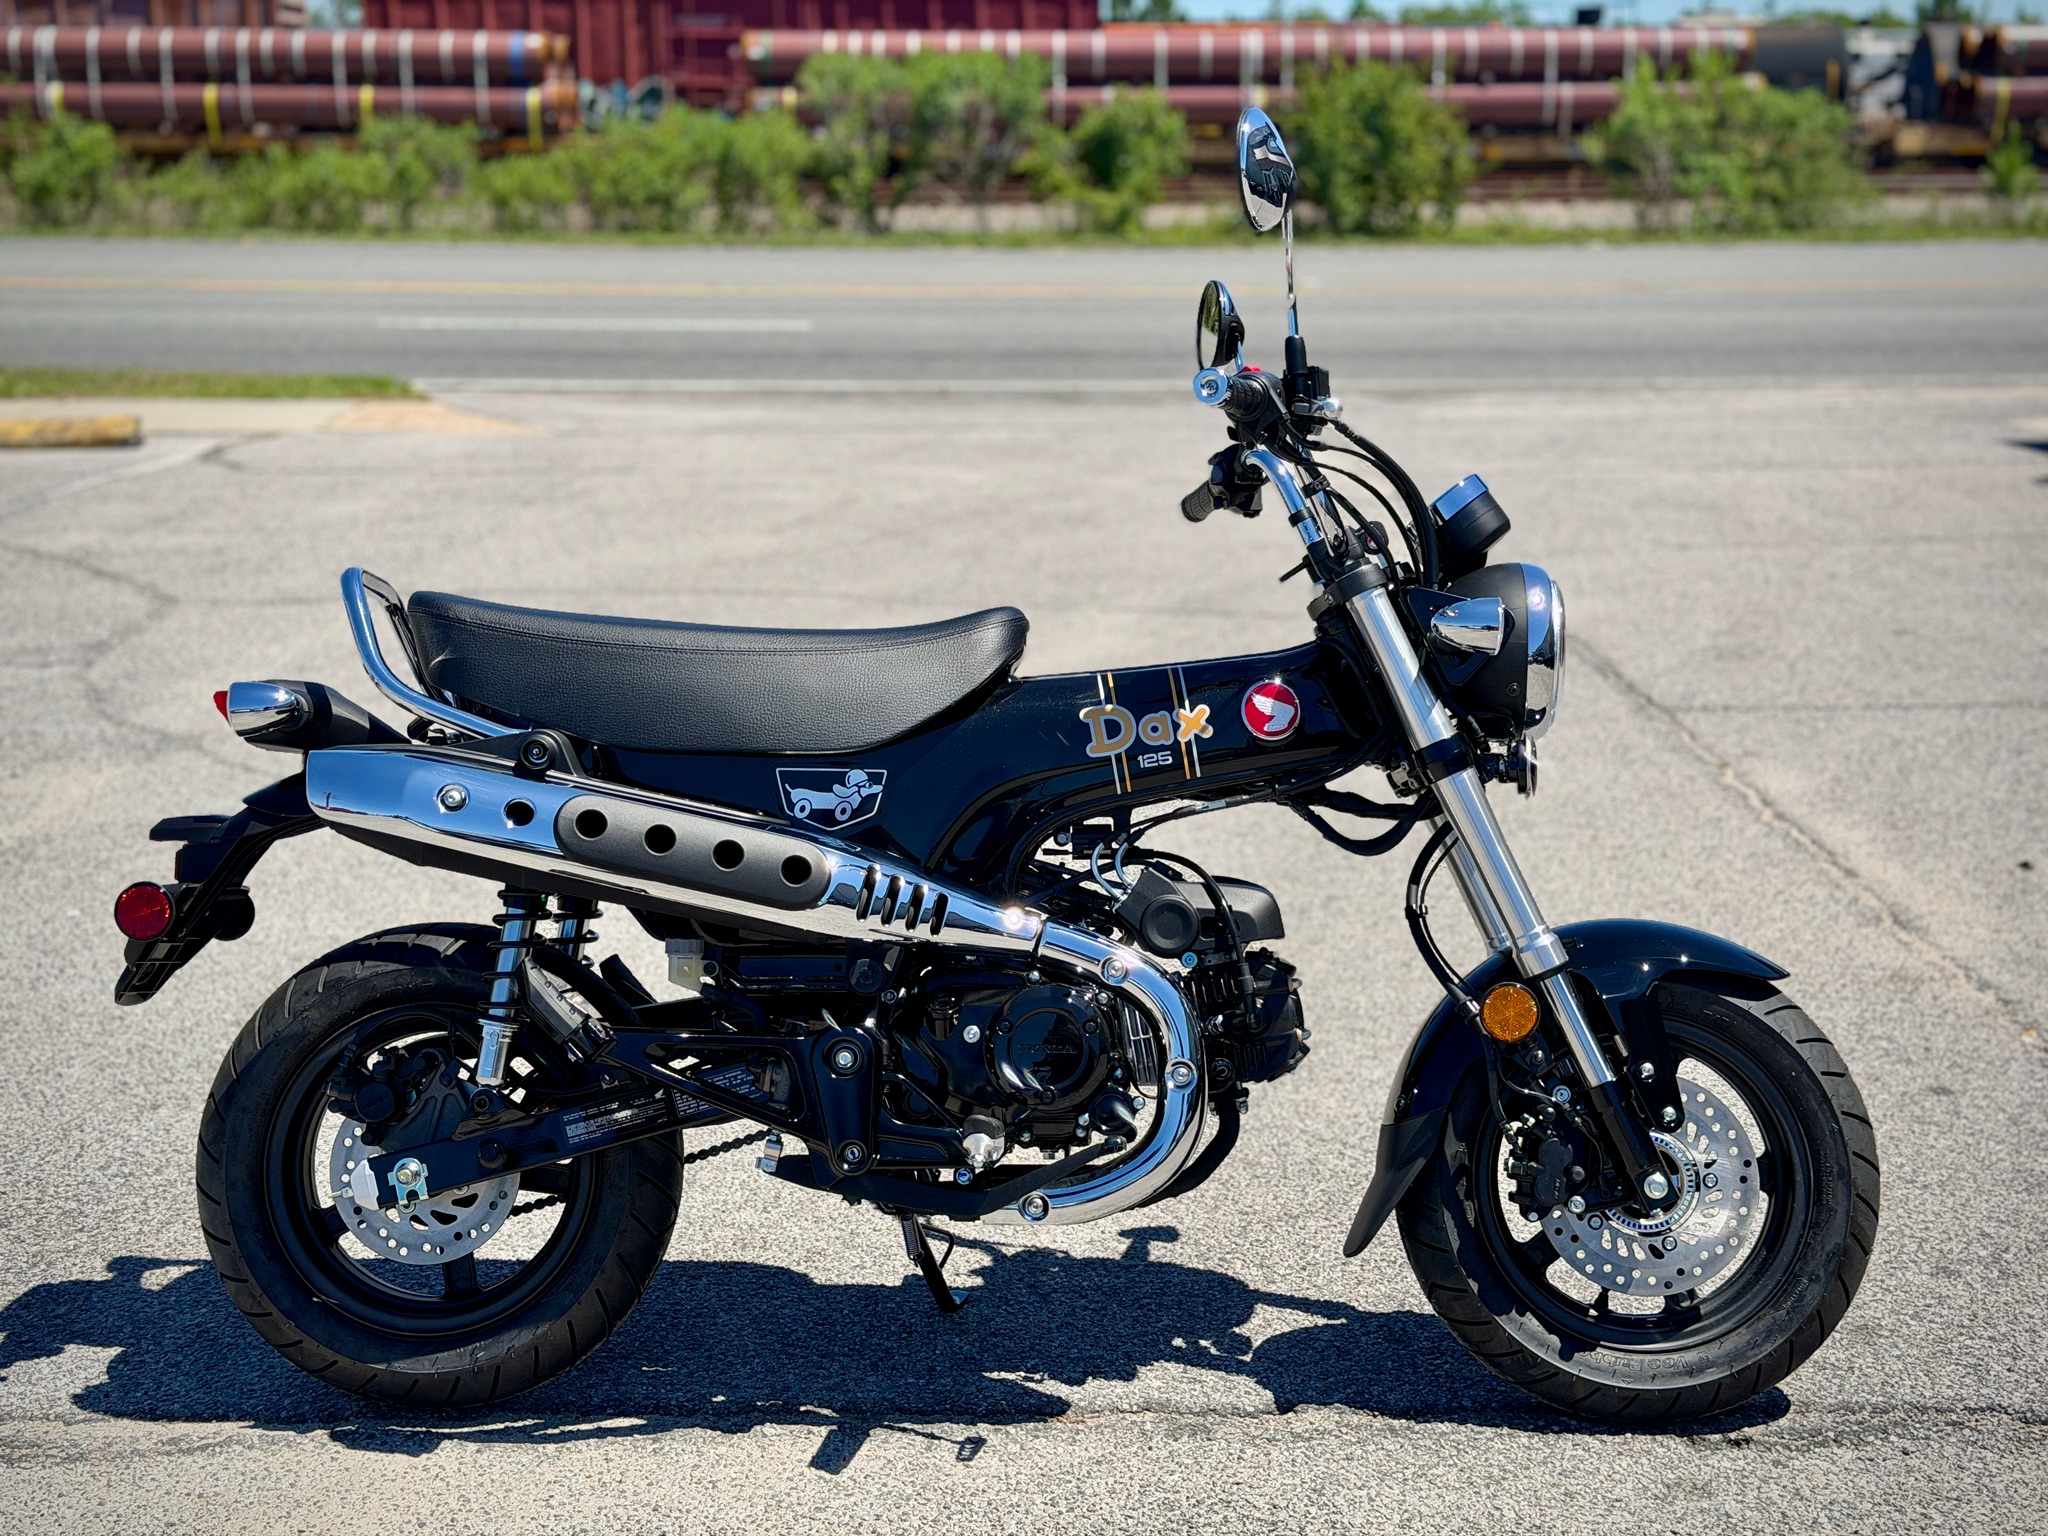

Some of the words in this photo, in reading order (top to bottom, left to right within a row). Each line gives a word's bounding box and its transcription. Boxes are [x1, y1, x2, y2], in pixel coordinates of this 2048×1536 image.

[1079, 703, 1214, 758] Dax
[1137, 751, 1173, 769] 125
[1017, 1043, 1078, 1055] HONDA
